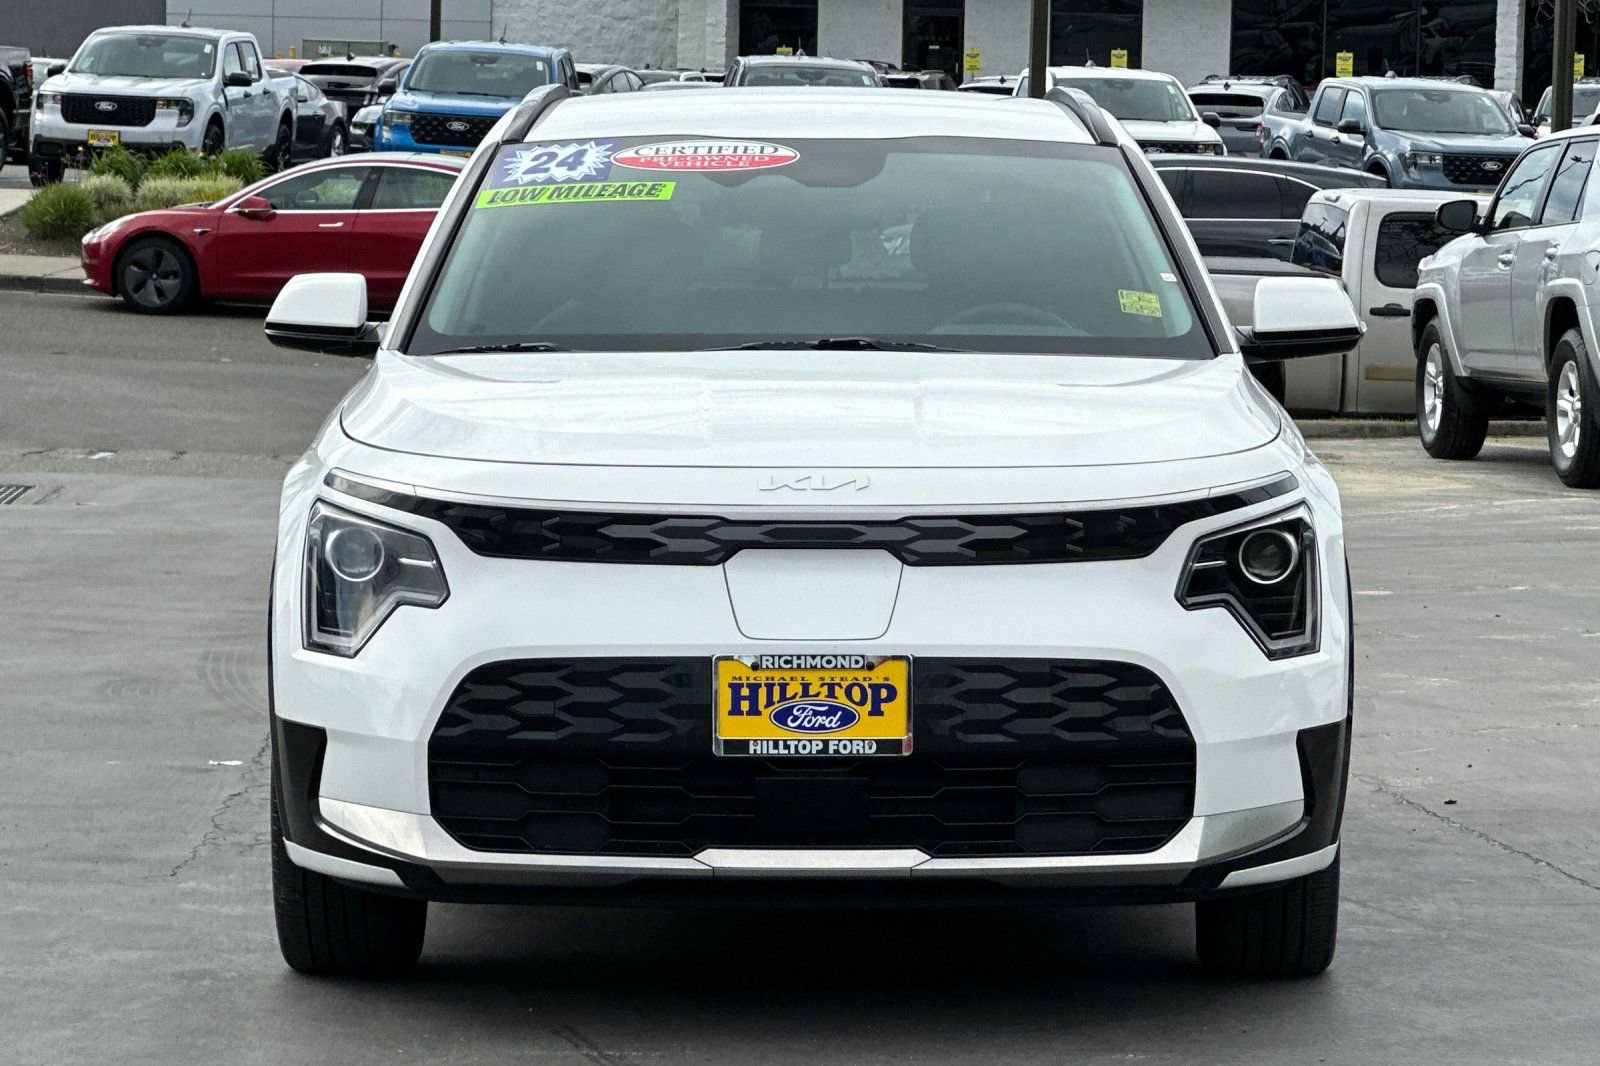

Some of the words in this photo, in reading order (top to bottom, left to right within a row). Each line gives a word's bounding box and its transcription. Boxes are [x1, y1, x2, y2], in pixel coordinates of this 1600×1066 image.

[634, 145, 779, 156] CERTIFIED
[639, 155, 770, 163] PRE-OWNED
[520, 148, 588, 175] 24
[486, 186, 549, 205] LOW
[546, 183, 667, 200] MILEAGE
[758, 472, 871, 491] KIA
[761, 655, 864, 669] RICHMOND
[727, 682, 898, 717] HILLTOP
[787, 704, 843, 728] Ford
[749, 740, 825, 755] HILLTOP
[828, 740, 877, 754] FORD
